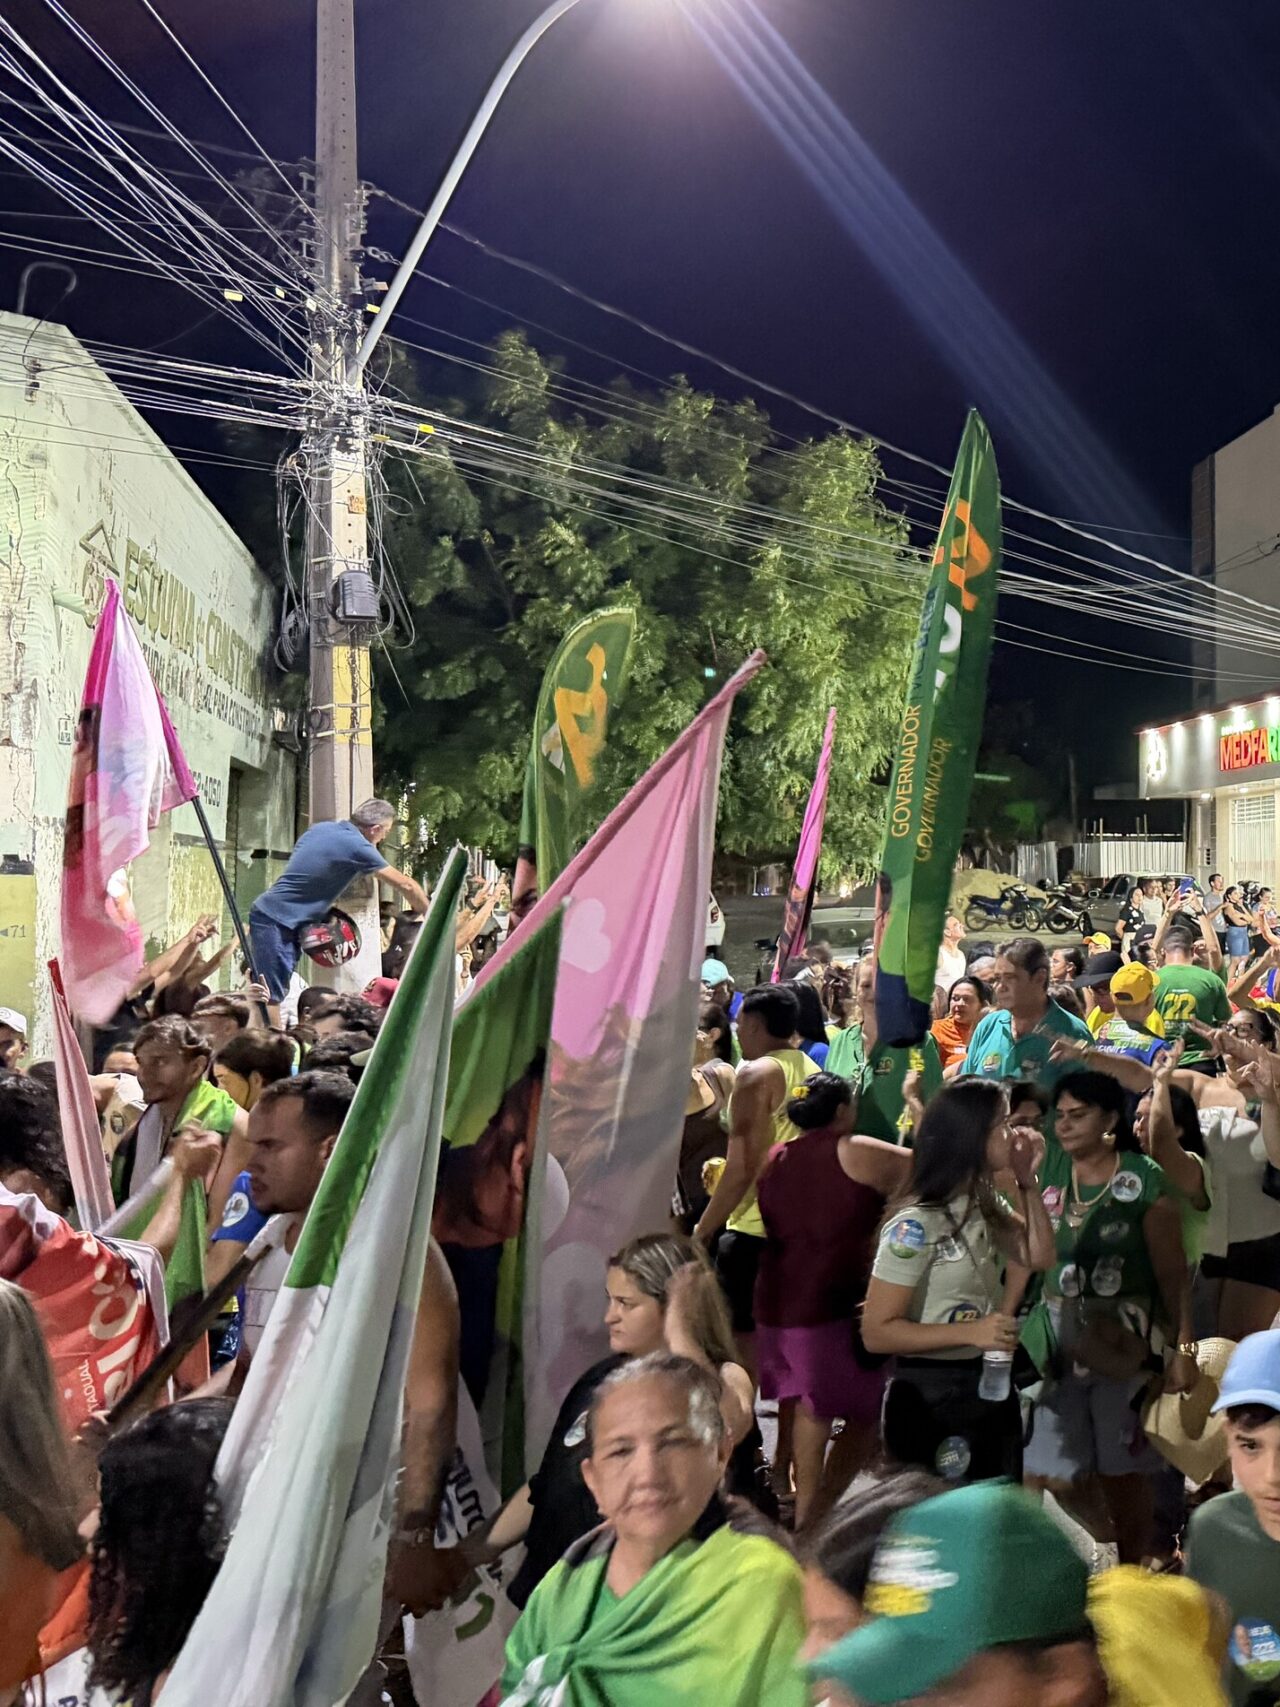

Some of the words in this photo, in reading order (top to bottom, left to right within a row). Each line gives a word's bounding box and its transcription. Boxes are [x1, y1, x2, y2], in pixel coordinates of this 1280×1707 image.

[891, 704, 922, 838] GOVERNADOR
[10, 924, 26, 938] 71
[1163, 992, 1197, 1020] 22
[78, 1359, 99, 1412] TADUAL
